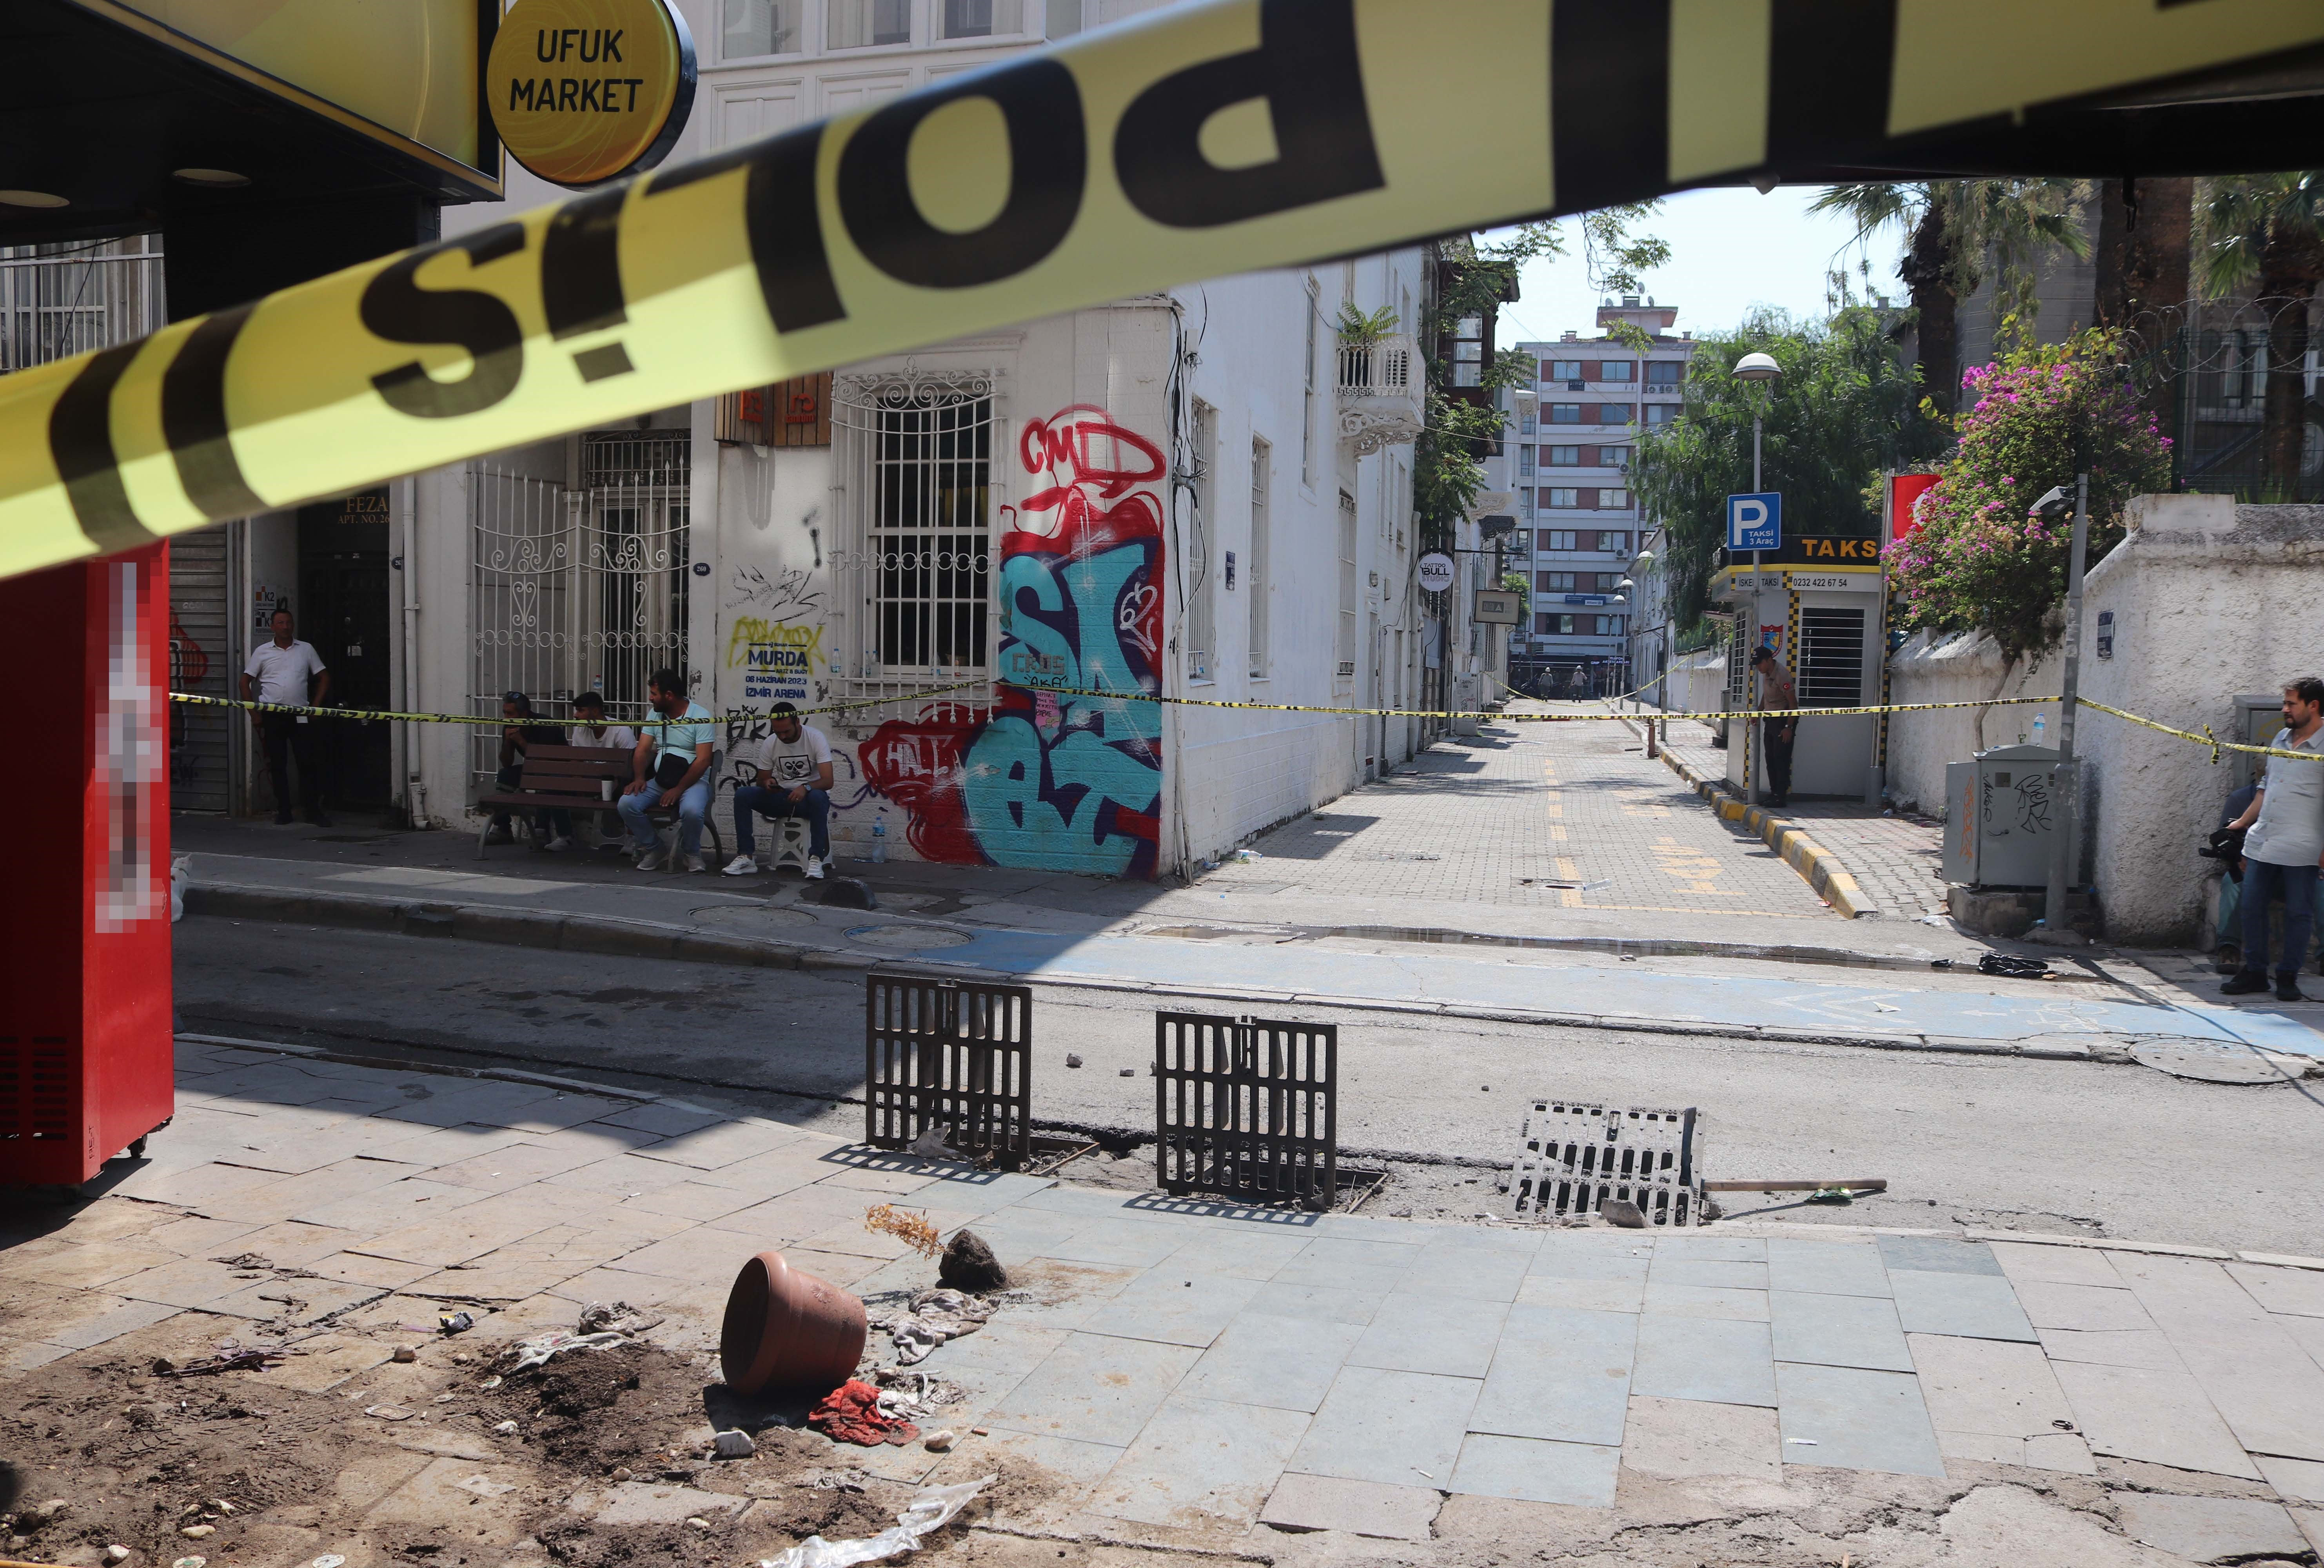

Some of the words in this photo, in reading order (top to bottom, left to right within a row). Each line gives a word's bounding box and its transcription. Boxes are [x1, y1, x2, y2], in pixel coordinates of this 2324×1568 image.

[537, 29, 623, 63] UFUK
[510, 78, 643, 112] MARKET
[346, 496, 389, 512] FEZA
[338, 515, 358, 524] APT.
[361, 514, 378, 524] NO.
[1733, 499, 1768, 546] P
[1748, 529, 1774, 537] TAKSİ
[1802, 539, 1877, 557] TAKS
[1761, 576, 1779, 586] TAKSİ
[1793, 578, 1810, 586] 0232
[1812, 578, 1825, 586] 422
[1828, 579, 1836, 587] 67
[1839, 579, 1847, 587] 54
[748, 650, 808, 666] MURDA
[746, 686, 772, 697] İZMİR
[774, 688, 806, 699] ARENA
